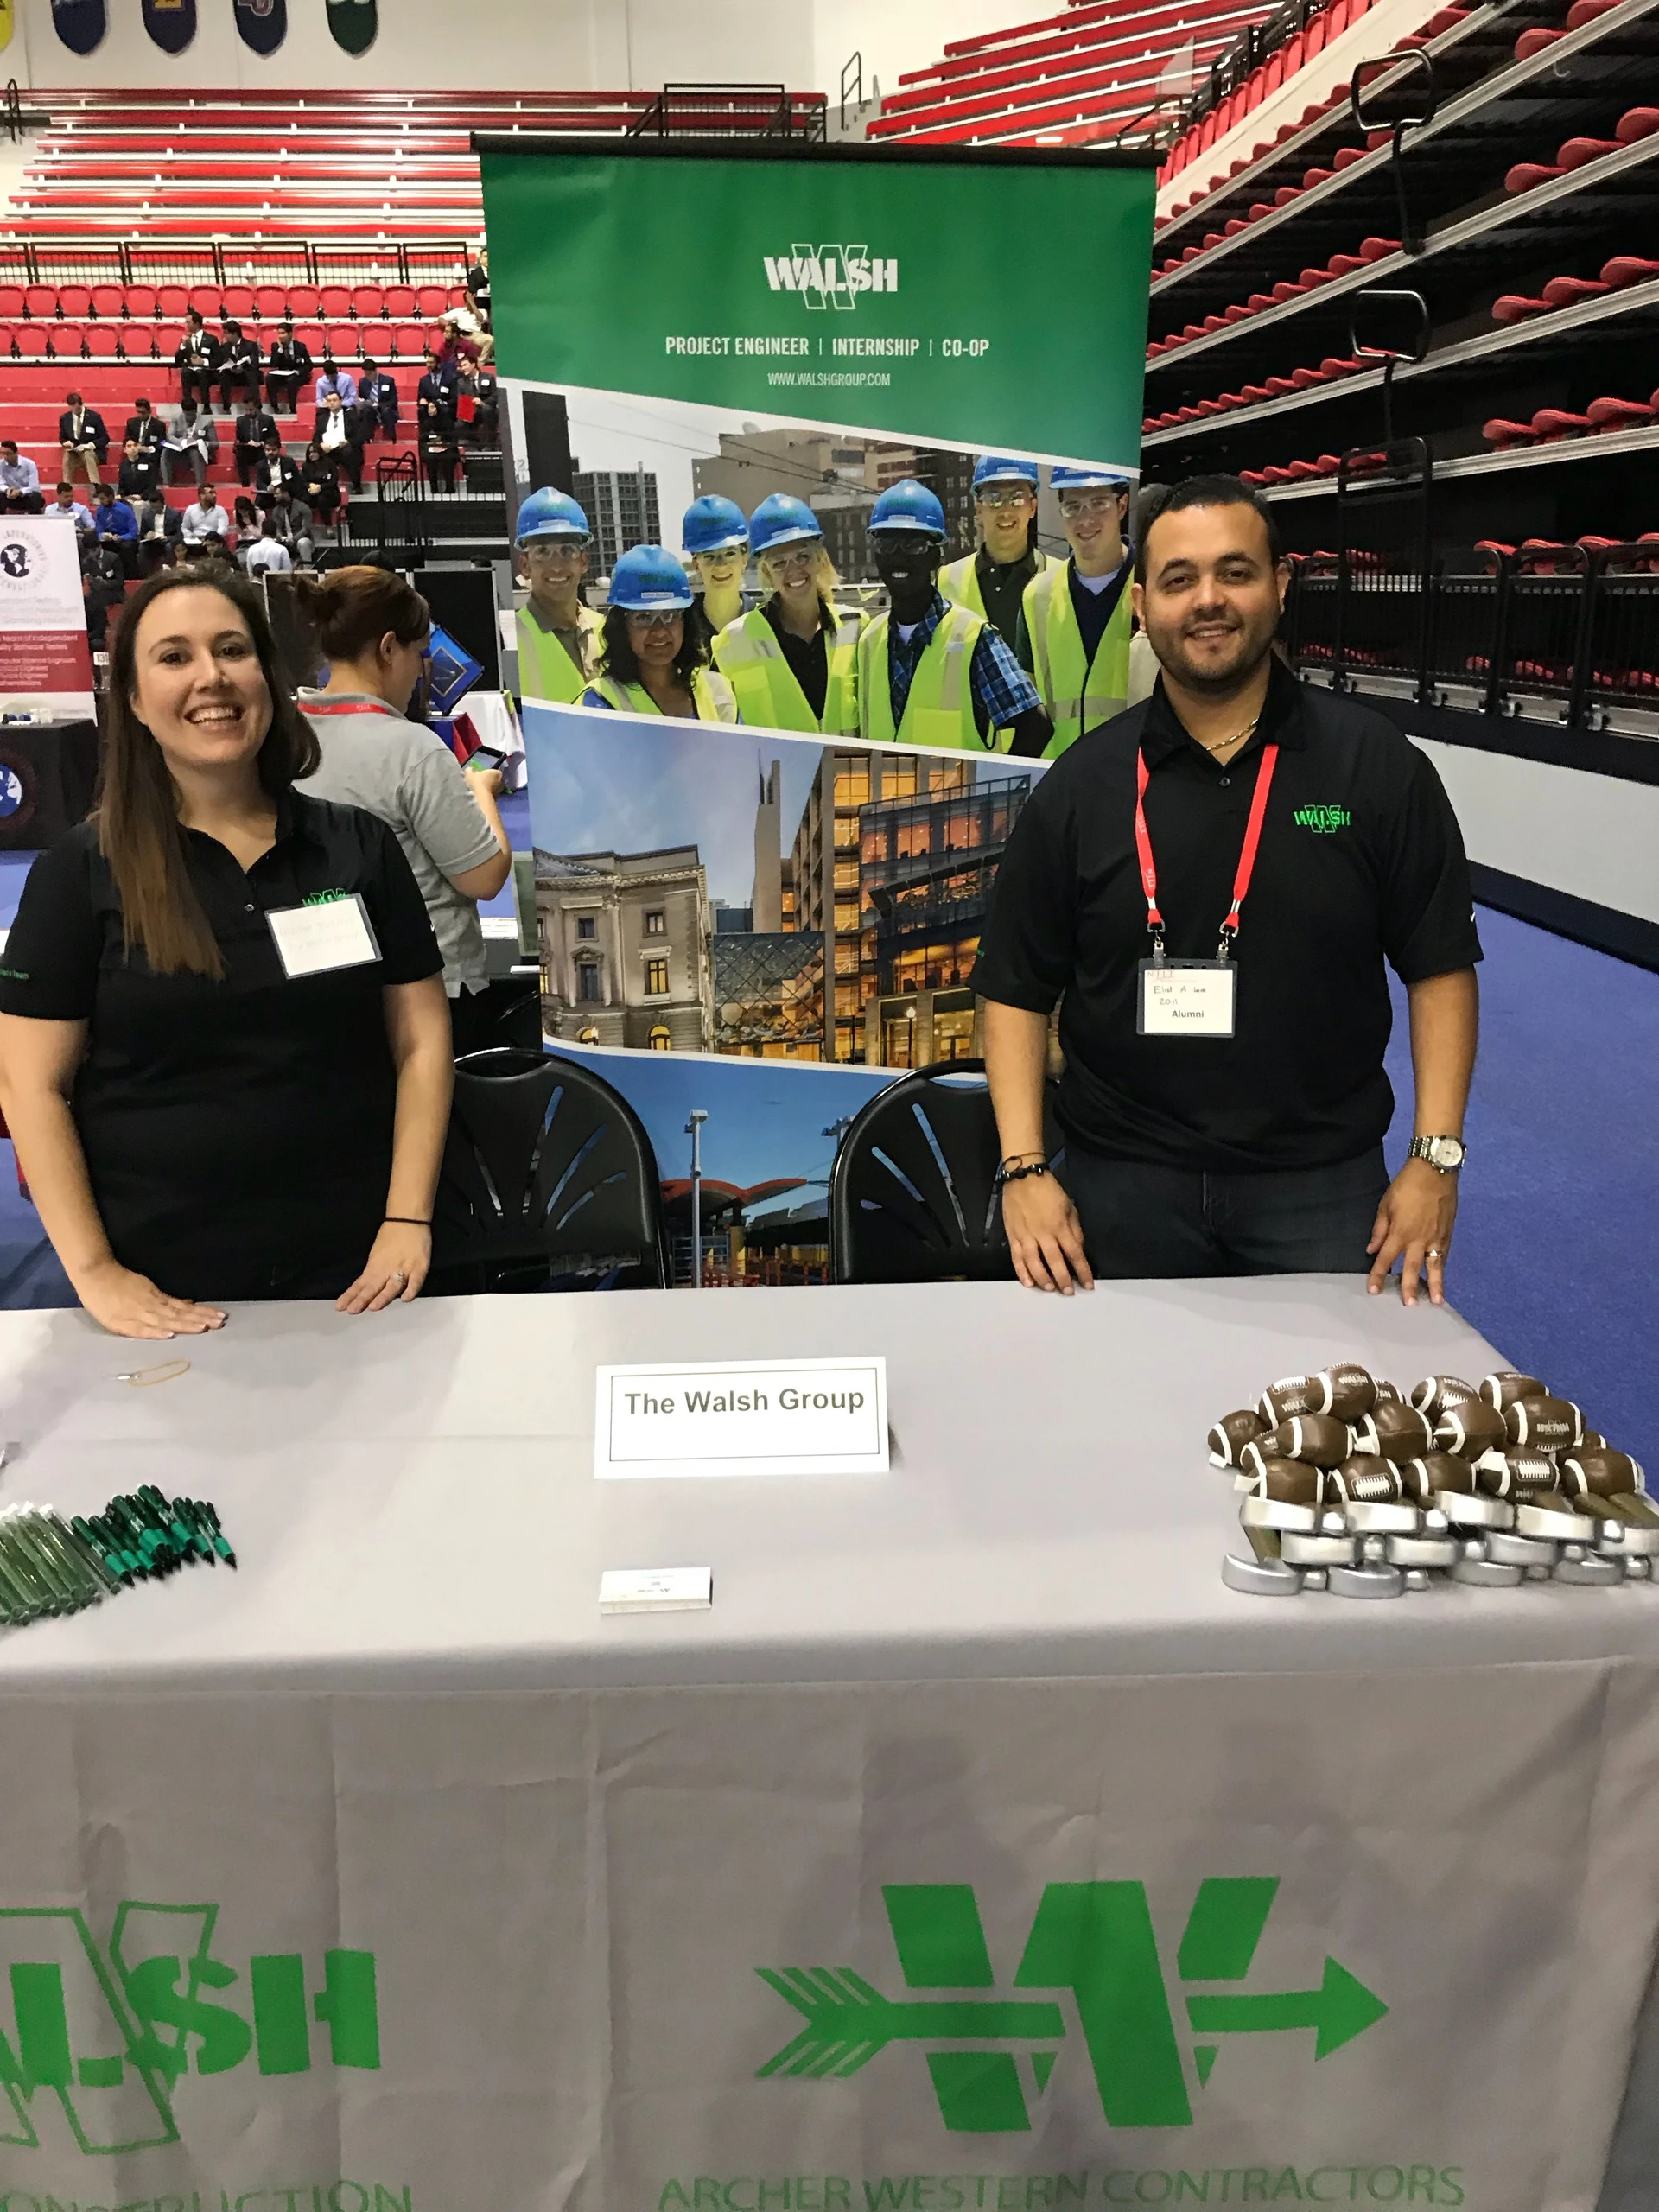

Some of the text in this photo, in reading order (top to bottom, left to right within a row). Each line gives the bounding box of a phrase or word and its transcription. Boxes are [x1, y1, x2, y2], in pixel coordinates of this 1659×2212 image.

[764, 257, 899, 292] WALSH
[665, 336, 990, 357] PROJECT ENGINEER INTERNSHIP CO-OP
[767, 372, 891, 387] WWW.WALSHGROUP.COM
[1294, 811, 1351, 826] WALSH
[625, 1388, 865, 1414] The Walsh Group
[658, 2164, 1465, 2212] ARCHER WESTERN CONTRACTORS
